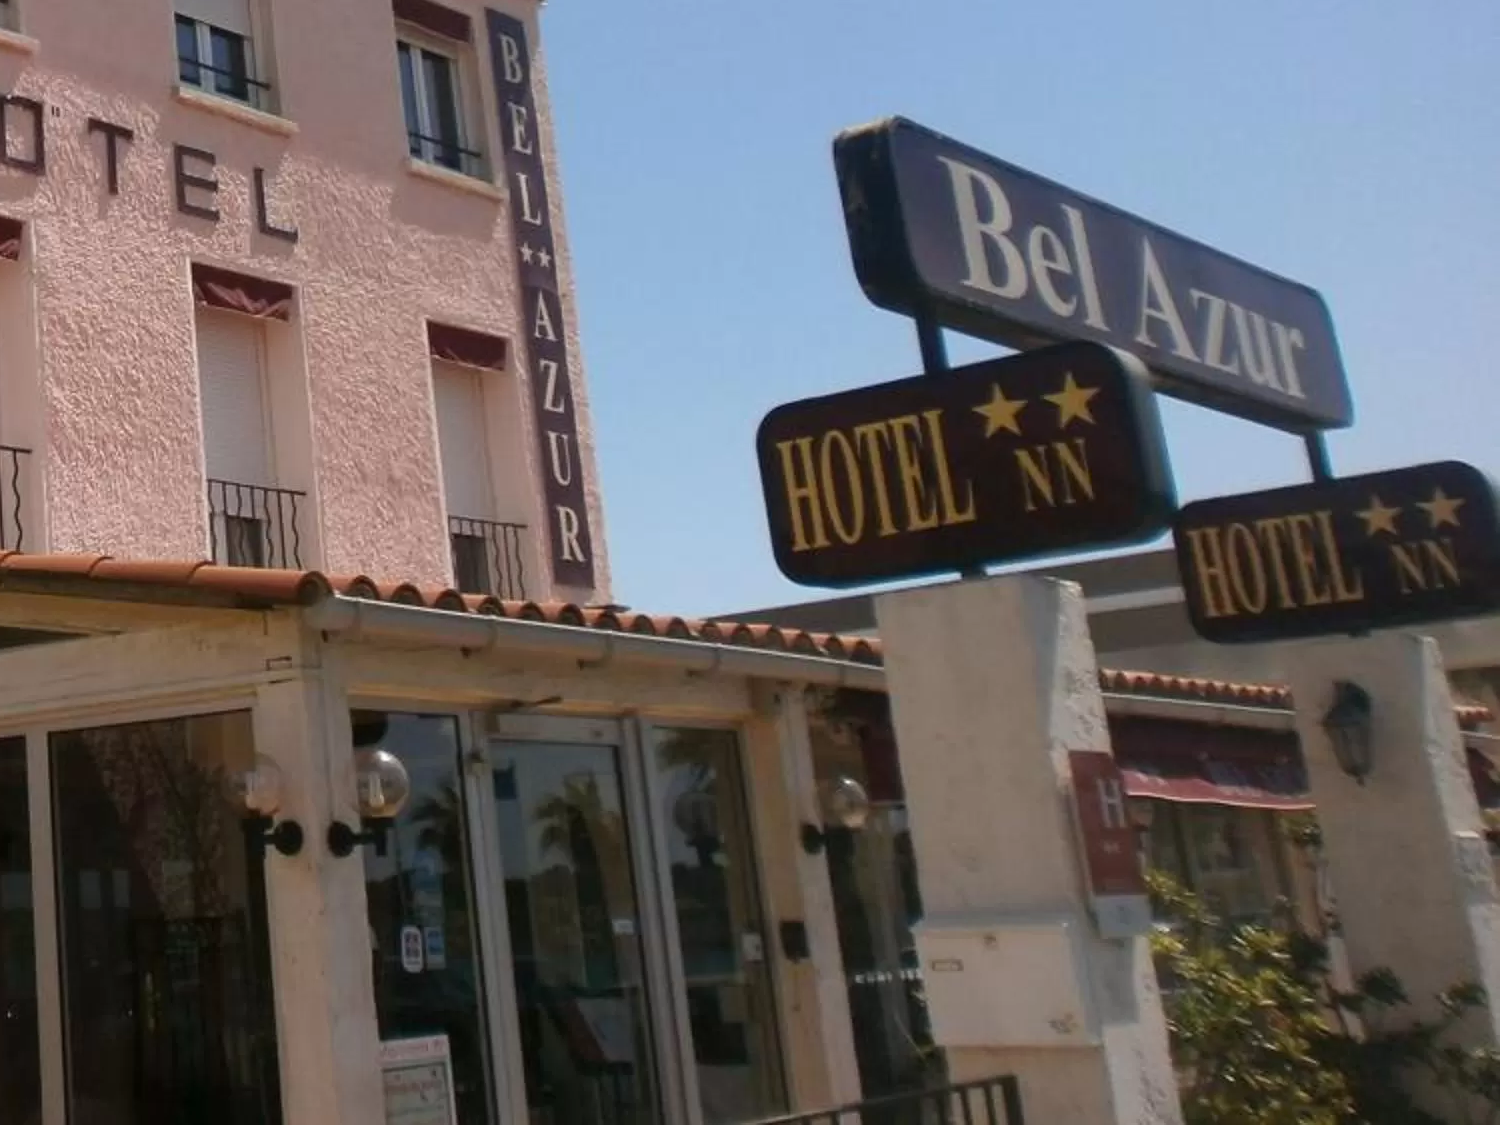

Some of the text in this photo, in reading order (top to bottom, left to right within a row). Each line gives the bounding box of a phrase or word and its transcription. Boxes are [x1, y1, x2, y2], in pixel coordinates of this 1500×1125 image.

[499, 32, 585, 564] BEL AZUR
[937, 155, 1308, 400] Bel Azur
[776, 408, 977, 552] HOTEL
[1013, 437, 1096, 512] NN
[1185, 510, 1365, 618] HOTEL
[1388, 537, 1461, 595] NN
